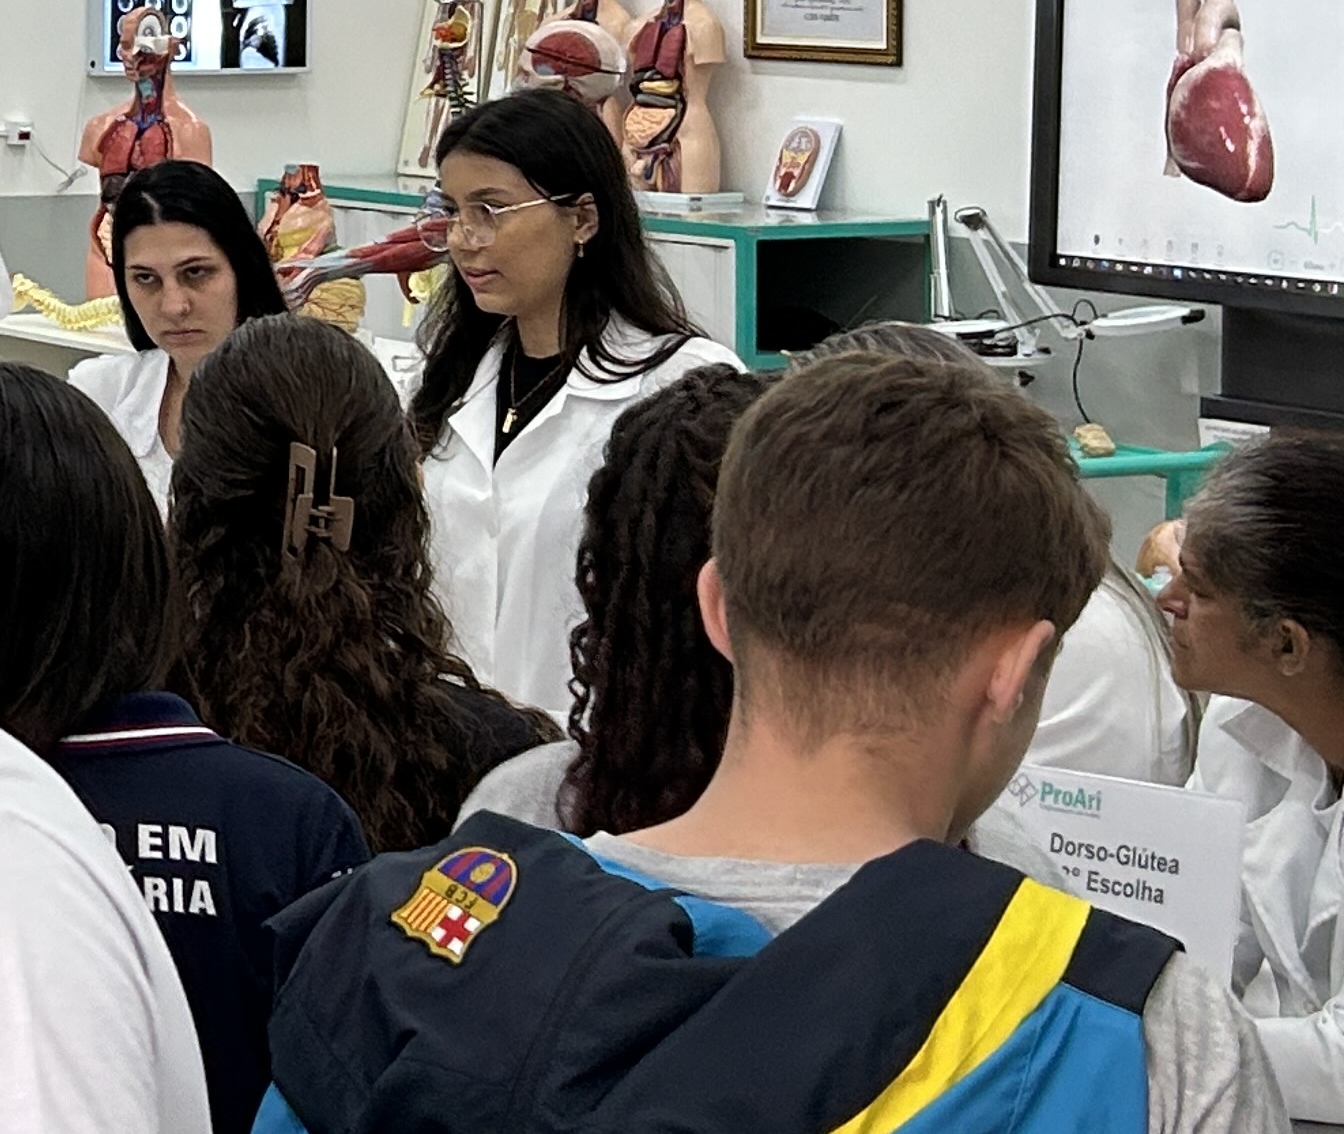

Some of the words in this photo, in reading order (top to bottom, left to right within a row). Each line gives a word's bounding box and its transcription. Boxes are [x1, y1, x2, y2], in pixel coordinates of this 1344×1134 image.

[1040, 780, 1103, 812] ProAri
[137, 823, 218, 864] EM
[1050, 832, 1180, 875] Dorso-Glútea
[141, 875, 217, 917] RIA
[1086, 870, 1165, 905] Escolha
